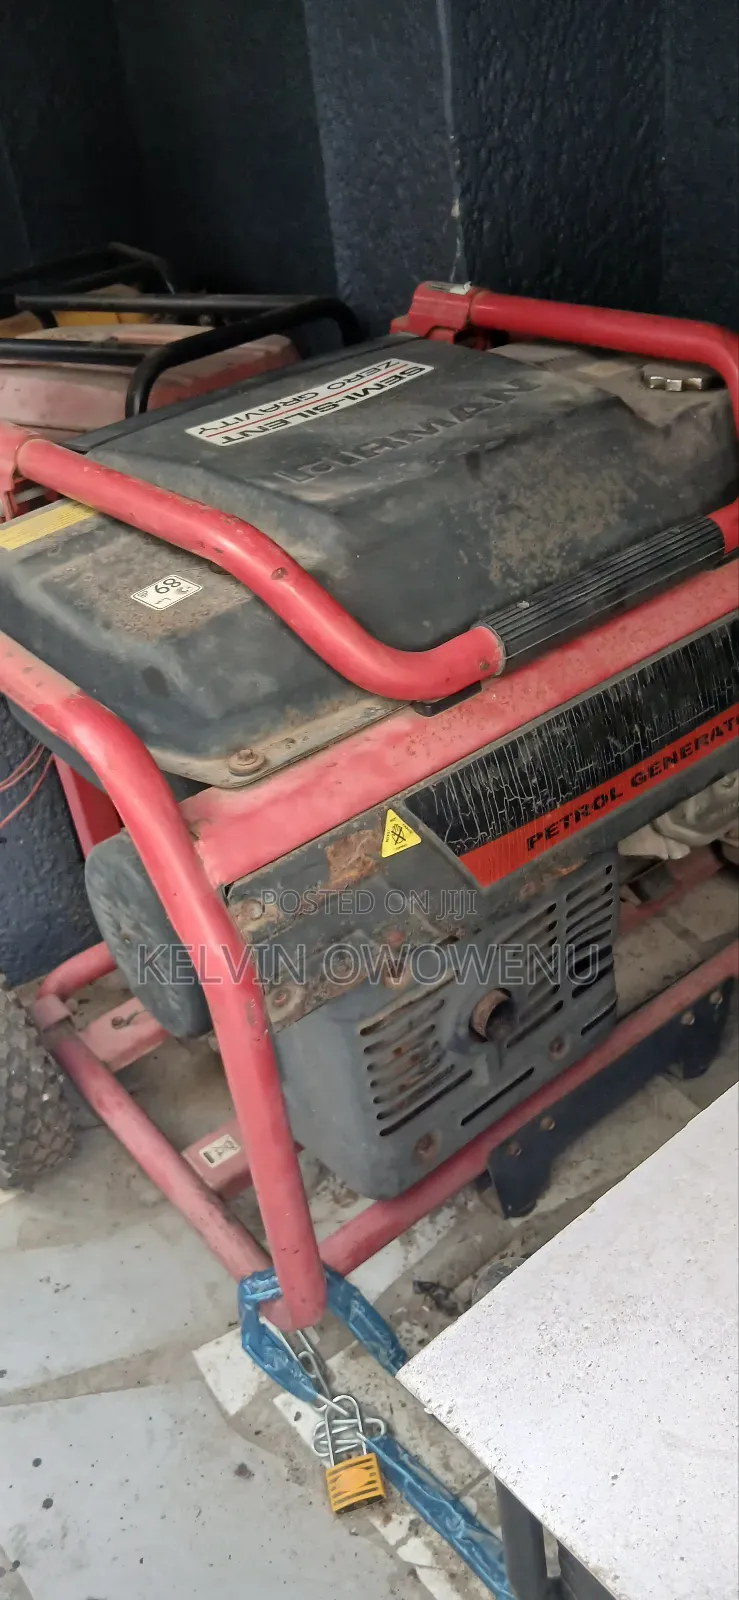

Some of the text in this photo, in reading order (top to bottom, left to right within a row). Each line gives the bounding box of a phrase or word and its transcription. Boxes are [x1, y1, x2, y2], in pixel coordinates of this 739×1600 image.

[198, 361, 400, 434] ZERO GRAVITY
[222, 367, 426, 444] SEMI-SILENT
[526, 787, 624, 851] PETROL
